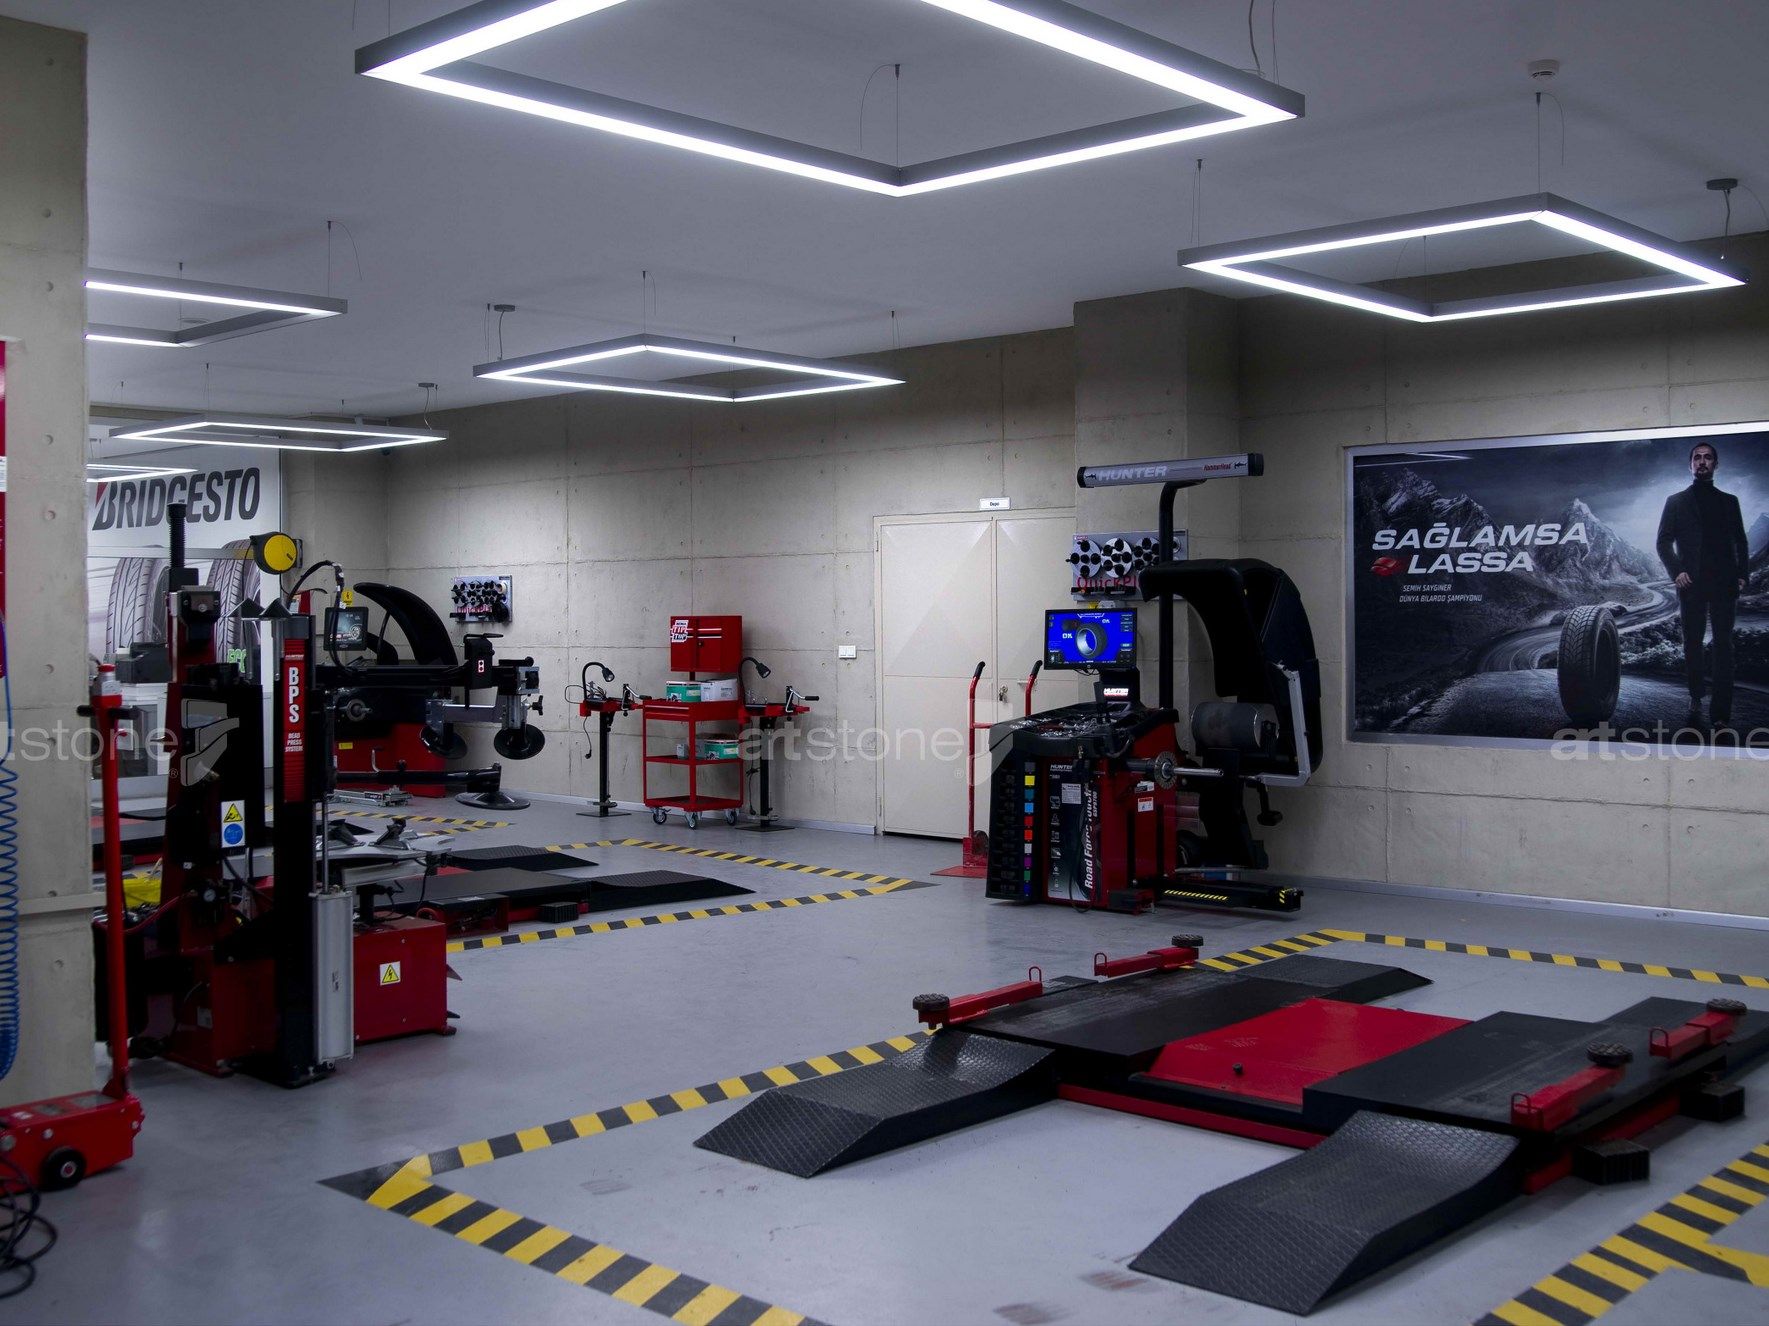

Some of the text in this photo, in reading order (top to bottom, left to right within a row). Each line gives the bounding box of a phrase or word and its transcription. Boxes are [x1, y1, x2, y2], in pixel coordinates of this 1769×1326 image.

[1098, 465, 1168, 481] HUNTER
[92, 467, 260, 530] BRIDGESTO
[1372, 522, 1589, 550] SAĞLAMSA
[1407, 551, 1534, 574] LASSA
[288, 666, 300, 724] BPS
[1084, 858, 1093, 889] Road
